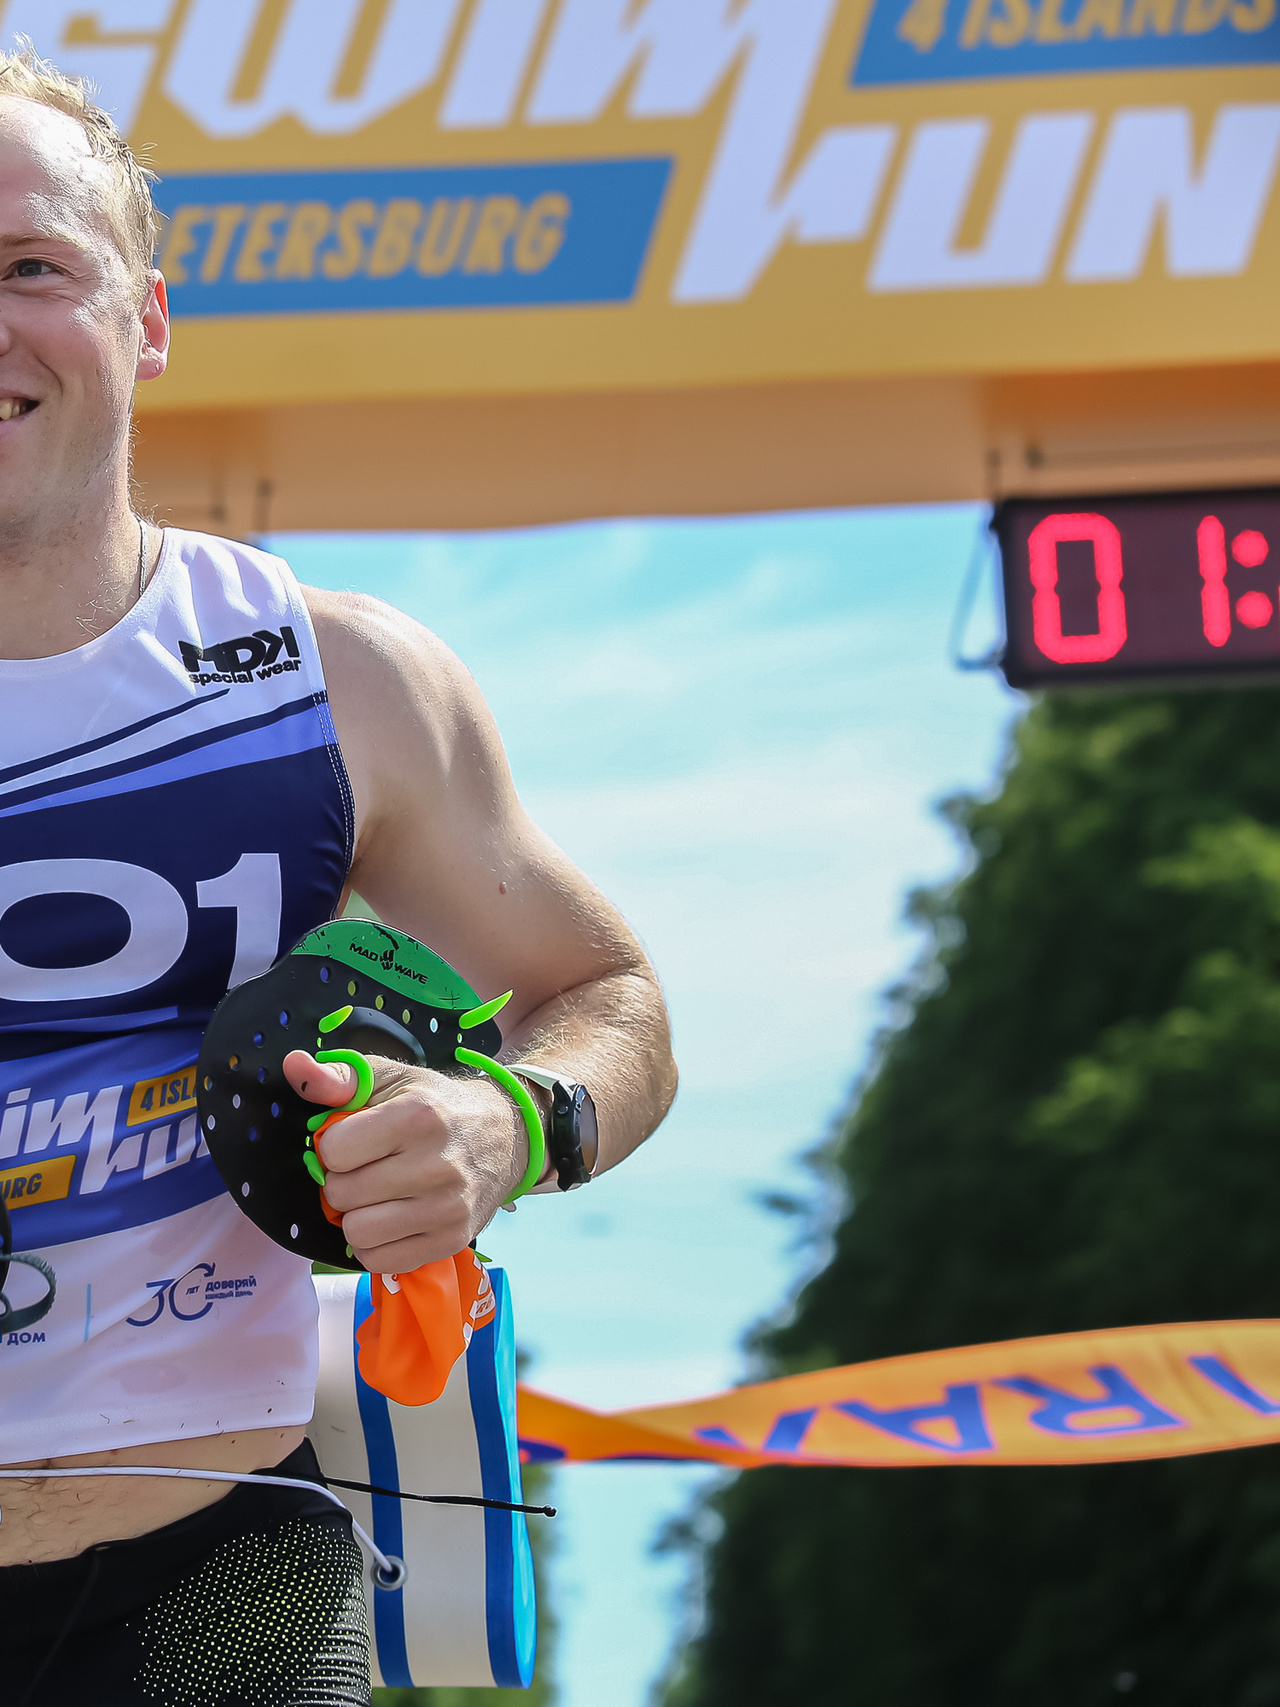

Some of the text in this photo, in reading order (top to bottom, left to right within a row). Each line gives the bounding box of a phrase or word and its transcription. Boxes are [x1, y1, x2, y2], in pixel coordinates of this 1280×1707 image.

[156, 192, 573, 284] ETERSBURG
[188, 660, 302, 687] special wear
[349, 942, 428, 985] MAD WAVE
[140, 1077, 197, 1112] 4 ISL
[205, 1275, 257, 1292] доверяй
[7, 1332, 46, 1346] ДОМ
